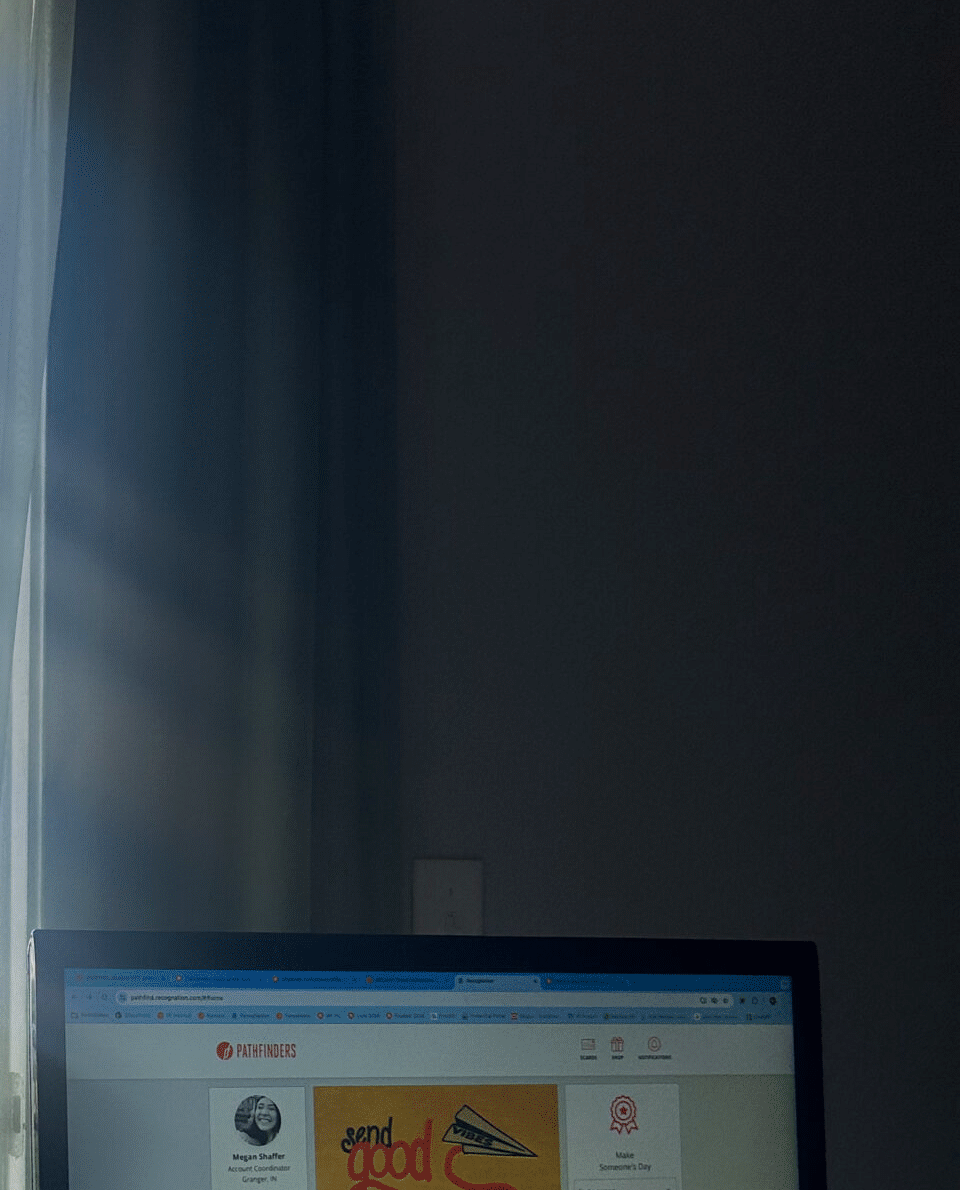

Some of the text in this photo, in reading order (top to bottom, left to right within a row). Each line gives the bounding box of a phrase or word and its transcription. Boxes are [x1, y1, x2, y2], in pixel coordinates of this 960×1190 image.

[236, 1043, 297, 1059] PATHFINDERS
[341, 1116, 394, 1154] send
[451, 1124, 496, 1148] VIBES
[233, 1154, 258, 1162] Megan
[599, 1163, 652, 1172] Someone's Day
